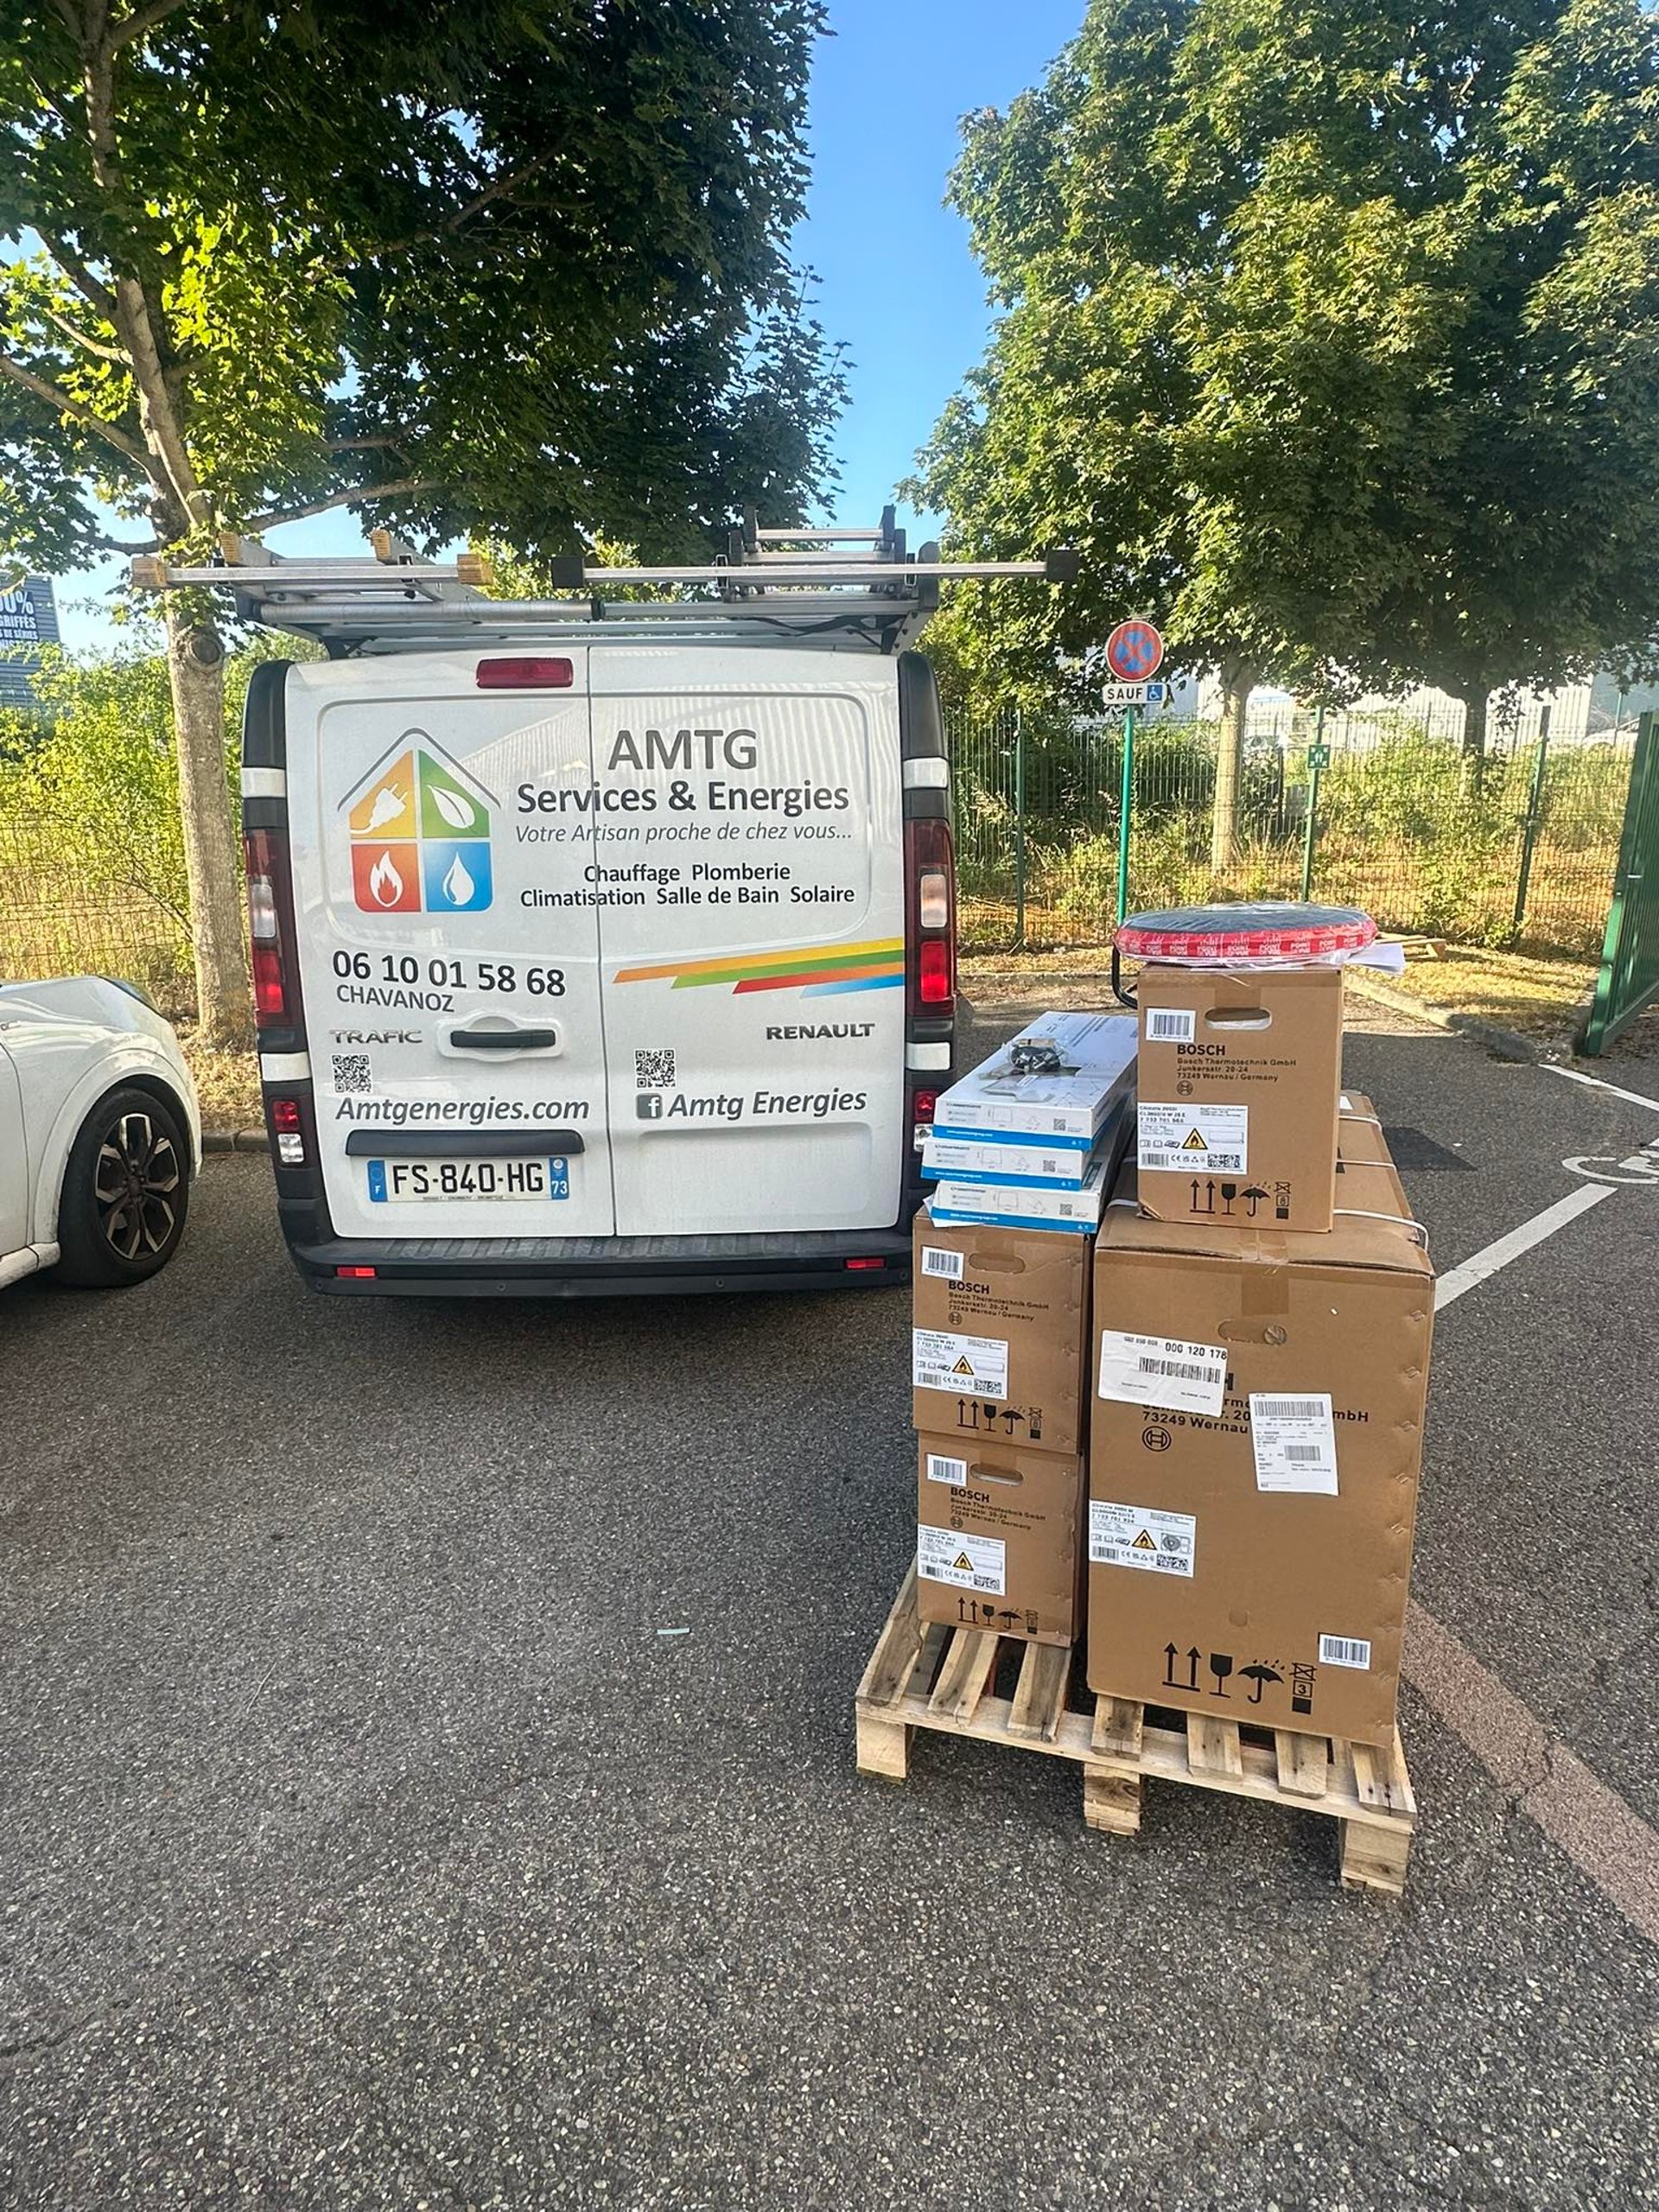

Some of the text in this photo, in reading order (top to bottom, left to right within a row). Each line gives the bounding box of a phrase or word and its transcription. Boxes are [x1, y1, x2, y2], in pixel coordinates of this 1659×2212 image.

[1107, 688, 1143, 700] SAUF
[607, 729, 757, 770] AMTG
[518, 780, 849, 817] Services & Energies
[516, 822, 852, 844] Votre Artisan proche de chez vous...
[584, 862, 791, 885] Chauffage Plomberie
[521, 885, 855, 907] Climatisation Salle de Bain Solaire
[333, 950, 566, 997] 06 10 01 58 68
[337, 984, 454, 1013] CHAVANOZ
[329, 1029, 423, 1044] TRAFIC
[766, 1023, 875, 1040] RENAULT
[1177, 1044, 1226, 1056] BOSCH
[335, 1096, 589, 1125] Amtgenergies.com
[667, 1094, 743, 1121] Amtg
[753, 1087, 867, 1117] Energies
[375, 1163, 568, 1195] F FS-840-HG 73
[949, 1280, 990, 1294] BOSCH
[1166, 1342, 1184, 1354] 000
[1188, 1346, 1205, 1357] 120
[1210, 1349, 1228, 1360] 178
[1142, 1411, 1186, 1426] 73249
[1190, 1417, 1249, 1434] Wernau
[1233, 1409, 1251, 1422] 20
[1332, 1409, 1369, 1422] mbH
[950, 1486, 990, 1503] BOSCH
[1298, 1684, 1306, 1694] 3
